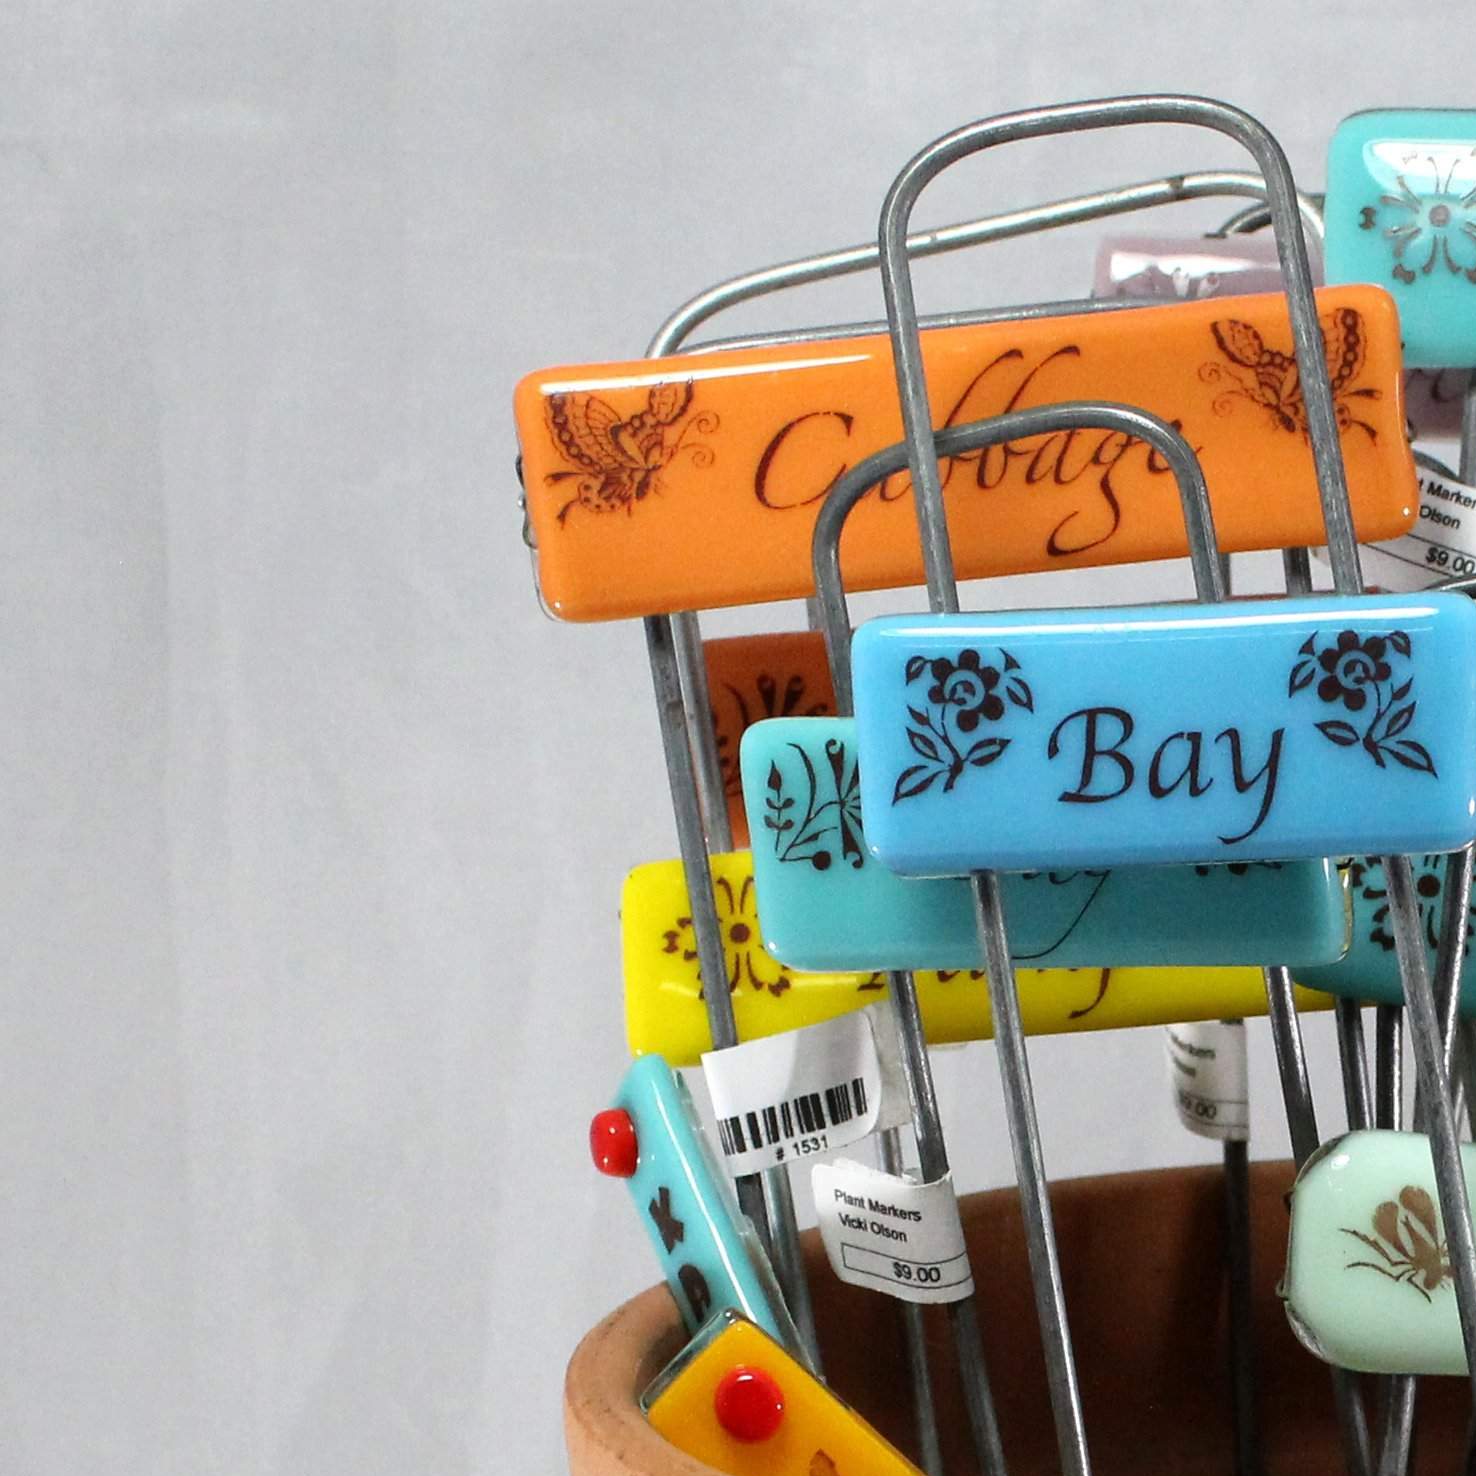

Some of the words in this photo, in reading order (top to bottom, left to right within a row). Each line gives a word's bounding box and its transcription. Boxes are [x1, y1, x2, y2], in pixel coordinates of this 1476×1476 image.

[1420, 505, 1461, 529] Olson
[1426, 547, 1475, 575] $9.00
[1047, 706, 1286, 844] Bay
[792, 1135, 829, 1156] 1531
[833, 1188, 865, 1210] Plant
[868, 1198, 922, 1222] Markers
[838, 1212, 868, 1232] Vicki
[870, 1221, 908, 1243] Olson
[891, 1261, 941, 1284] $9.00
